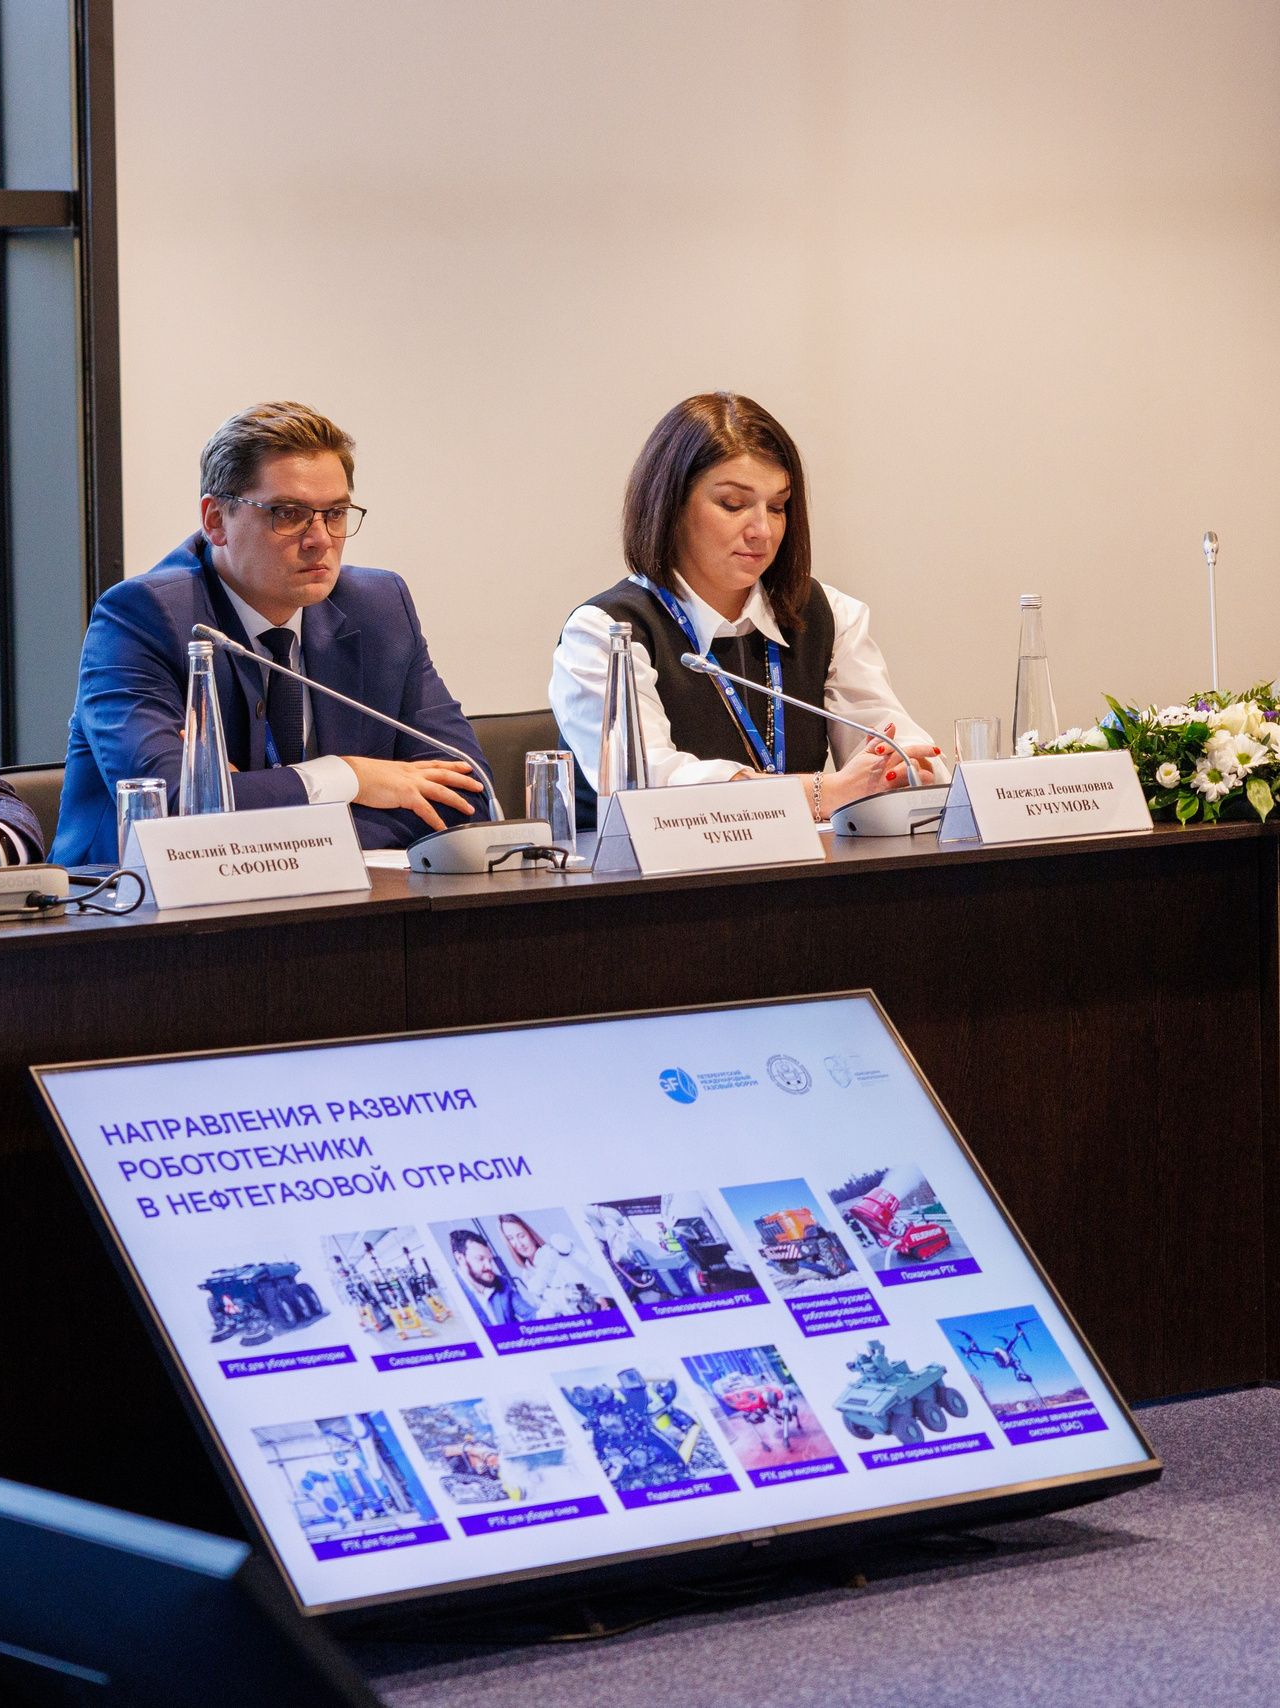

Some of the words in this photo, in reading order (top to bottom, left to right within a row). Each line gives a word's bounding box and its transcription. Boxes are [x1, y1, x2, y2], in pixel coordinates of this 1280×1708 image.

[995, 787, 1045, 800] Надежда
[1048, 781, 1114, 796] Леонидовна
[1025, 799, 1100, 816] КУЧУМОВА
[653, 813, 708, 831] Дмитрий
[710, 809, 786, 824] Михайлович
[501, 828, 535, 840] BOSCH
[703, 828, 753, 844] ЧУКИН
[166, 844, 227, 862] Василий
[229, 836, 333, 855] Владимирович
[218, 857, 299, 877] САФОНОВ
[100, 1104, 322, 1146] НАПРАВЛЕНИЯ
[326, 1088, 477, 1123] РАЗВИТИЯ
[118, 1136, 373, 1182] РОБОТОТЕХНИКИ
[136, 1196, 160, 1219] В
[166, 1166, 396, 1216] НЕФТЕГАЗОВОЙ
[402, 1155, 532, 1189] ОТРАСЛИ
[901, 1268, 940, 1281] Пожарные
[940, 1264, 958, 1275] РТК
[733, 1294, 753, 1306] РТК
[791, 1296, 838, 1310] Автономный
[839, 1291, 872, 1304] грузовой
[802, 1303, 874, 1322] роботизированный
[519, 1318, 585, 1335] Промышленные
[806, 1318, 843, 1332] наземный
[844, 1314, 882, 1328] транспорт
[497, 1331, 569, 1350] коллаборативные
[570, 1325, 627, 1341] манипуляторы
[227, 1361, 248, 1373] РТК
[248, 1360, 264, 1372] для
[266, 1356, 296, 1371] уборки
[298, 1350, 347, 1367] территории
[389, 1353, 434, 1367] Складские
[435, 1349, 467, 1364] роботы
[999, 1414, 1049, 1430] Беспилотные
[1050, 1407, 1098, 1422] авиационные
[1028, 1427, 1061, 1438] системы
[1061, 1421, 1084, 1434] (БАС)
[871, 1452, 890, 1463] РТК
[890, 1450, 904, 1462] для
[904, 1446, 933, 1460] охраны
[941, 1438, 980, 1453] инспекции
[760, 1471, 778, 1482] РТК
[778, 1469, 793, 1480] для
[793, 1462, 835, 1477] инспекции
[646, 1487, 694, 1502] Подводные
[694, 1482, 712, 1494] РТК
[487, 1516, 508, 1528] РТК
[508, 1514, 523, 1527] для
[524, 1509, 554, 1526] уборки
[554, 1504, 579, 1517] снега
[341, 1540, 362, 1552] РТК
[362, 1539, 379, 1551] для
[380, 1531, 417, 1547] бурения
